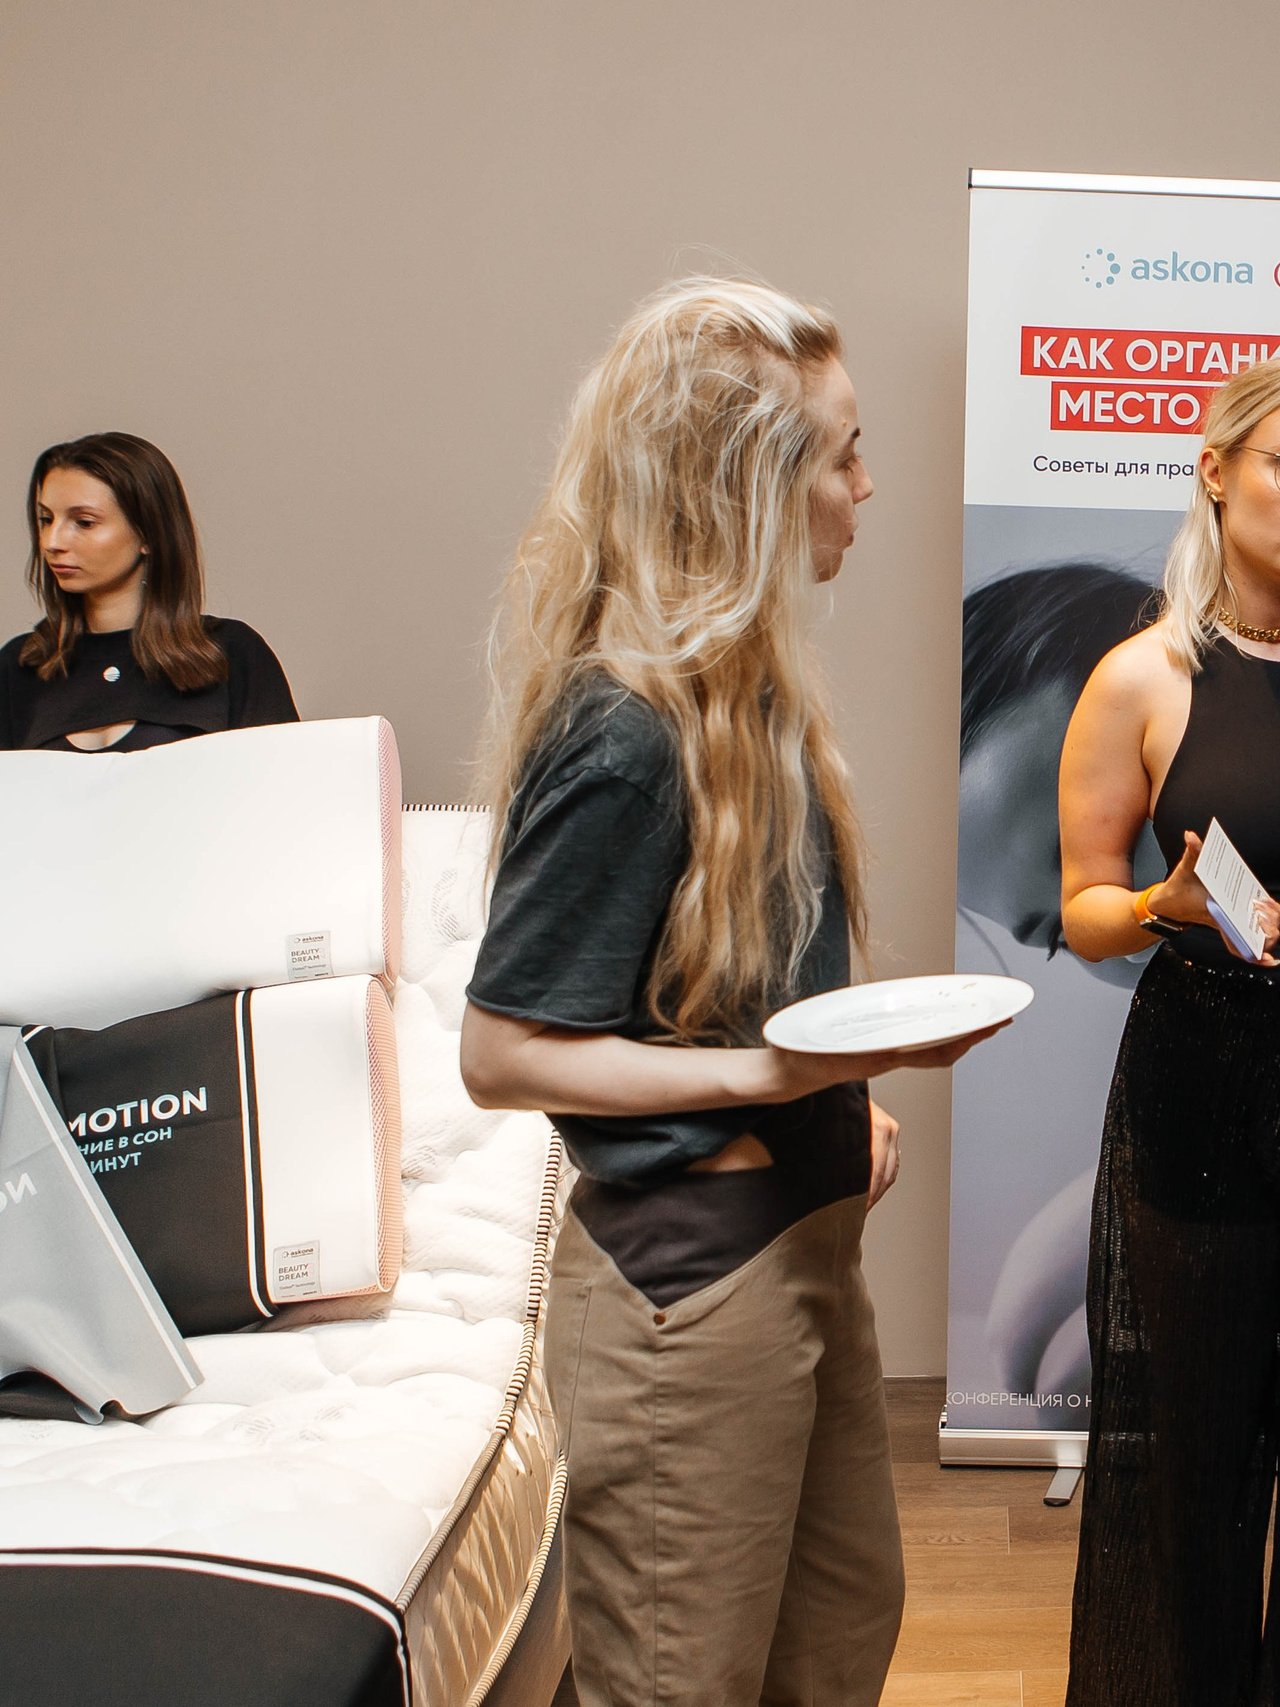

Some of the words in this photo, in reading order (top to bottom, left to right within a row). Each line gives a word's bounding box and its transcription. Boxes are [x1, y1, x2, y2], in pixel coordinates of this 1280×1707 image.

[1131, 251, 1254, 285] askona
[1033, 335, 1115, 371] КАК
[1059, 389, 1201, 427] МЕСТО
[1033, 455, 1109, 475] Советы
[1114, 462, 1150, 477] для
[291, 948, 320, 957] BEAUTY
[292, 954, 320, 964] DREAM
[118, 1136, 129, 1149] В
[132, 1126, 172, 1146] СОН
[278, 1263, 309, 1274] BEAUTY
[278, 1271, 309, 1282] DREAM
[1067, 1394, 1081, 1408] О
